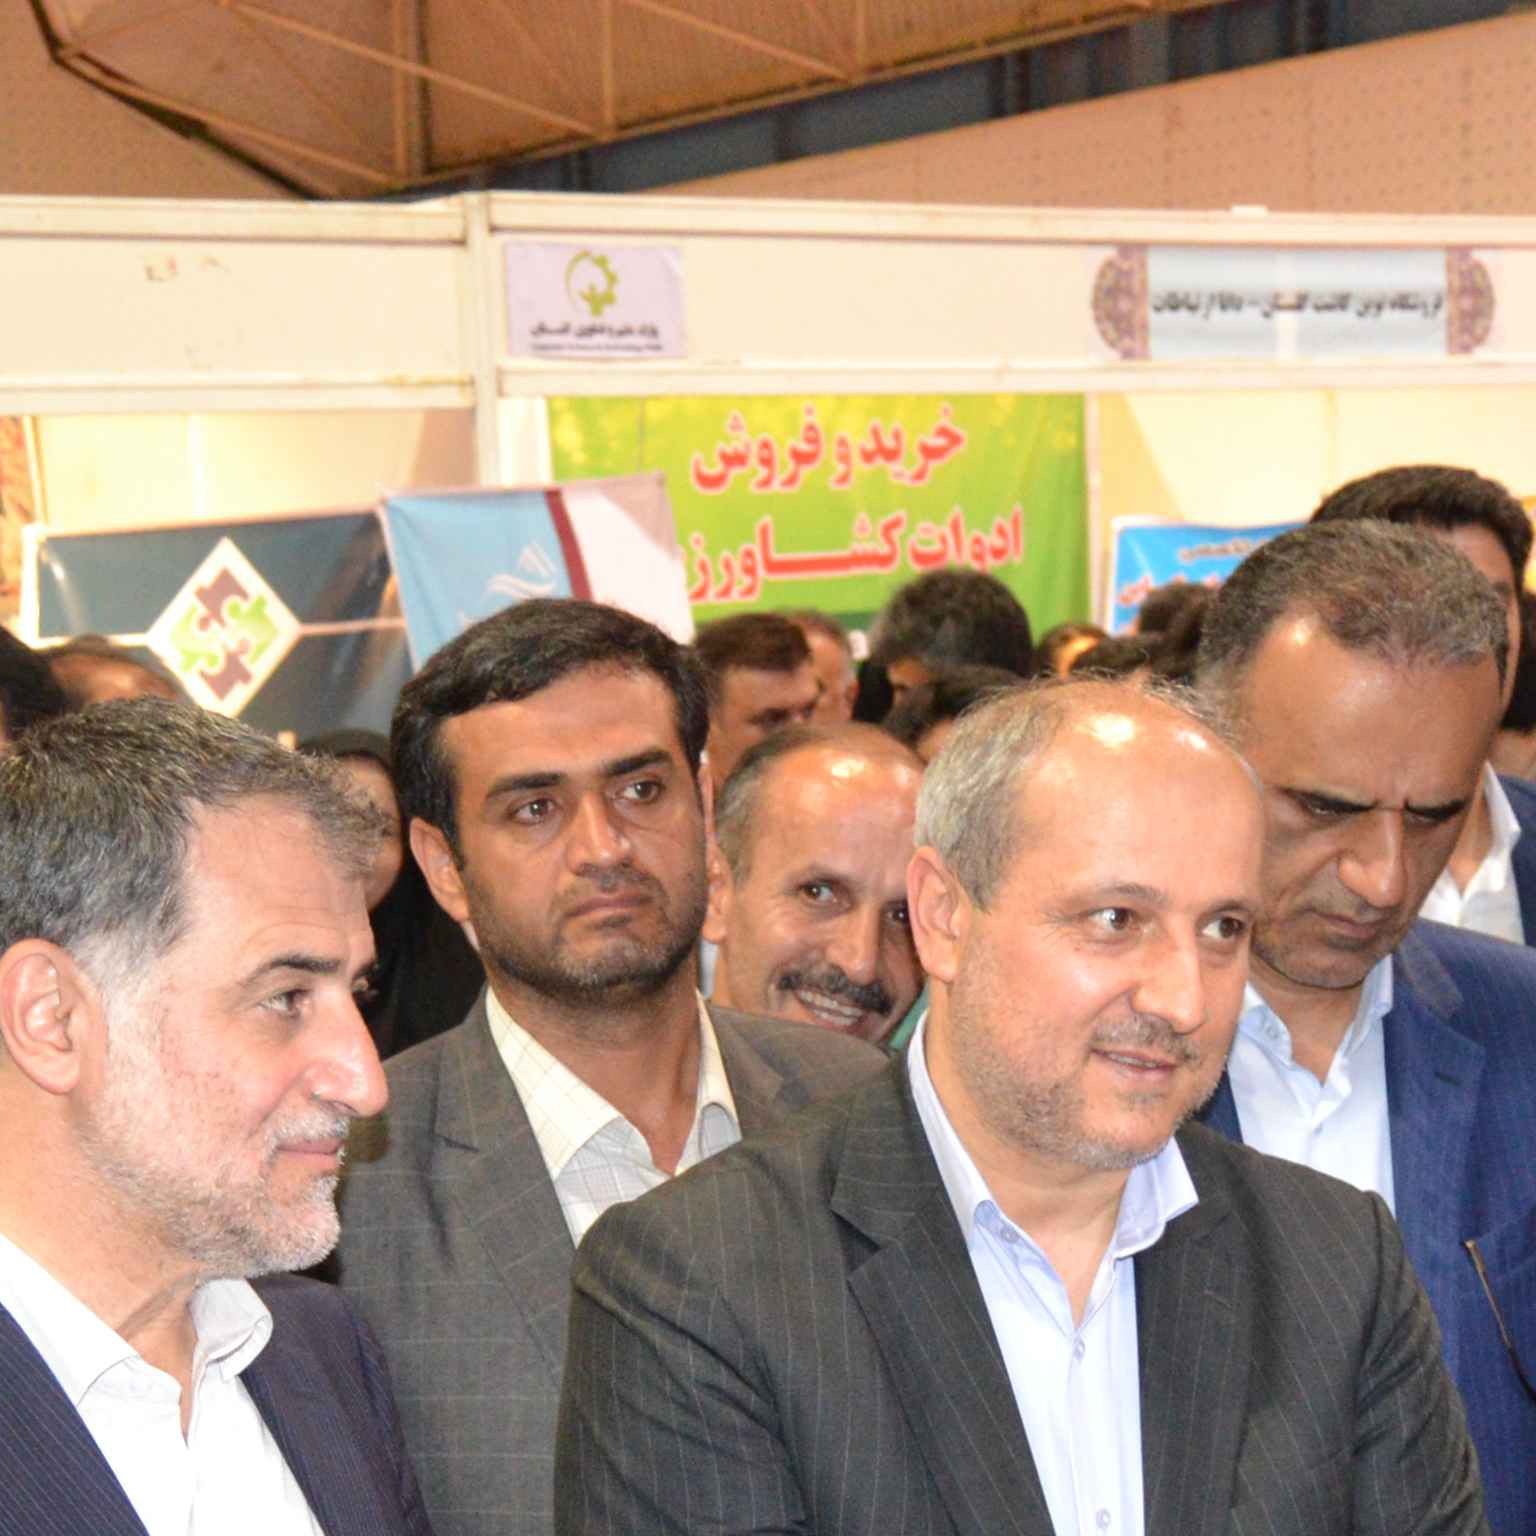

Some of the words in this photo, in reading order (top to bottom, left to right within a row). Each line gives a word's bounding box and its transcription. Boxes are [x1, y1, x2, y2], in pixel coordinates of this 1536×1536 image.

[693, 404, 824, 492] فروش
[832, 433, 853, 488] و
[859, 402, 965, 484] خرید
[687, 512, 908, 602] کشاورز
[907, 503, 1024, 573] ادوات
